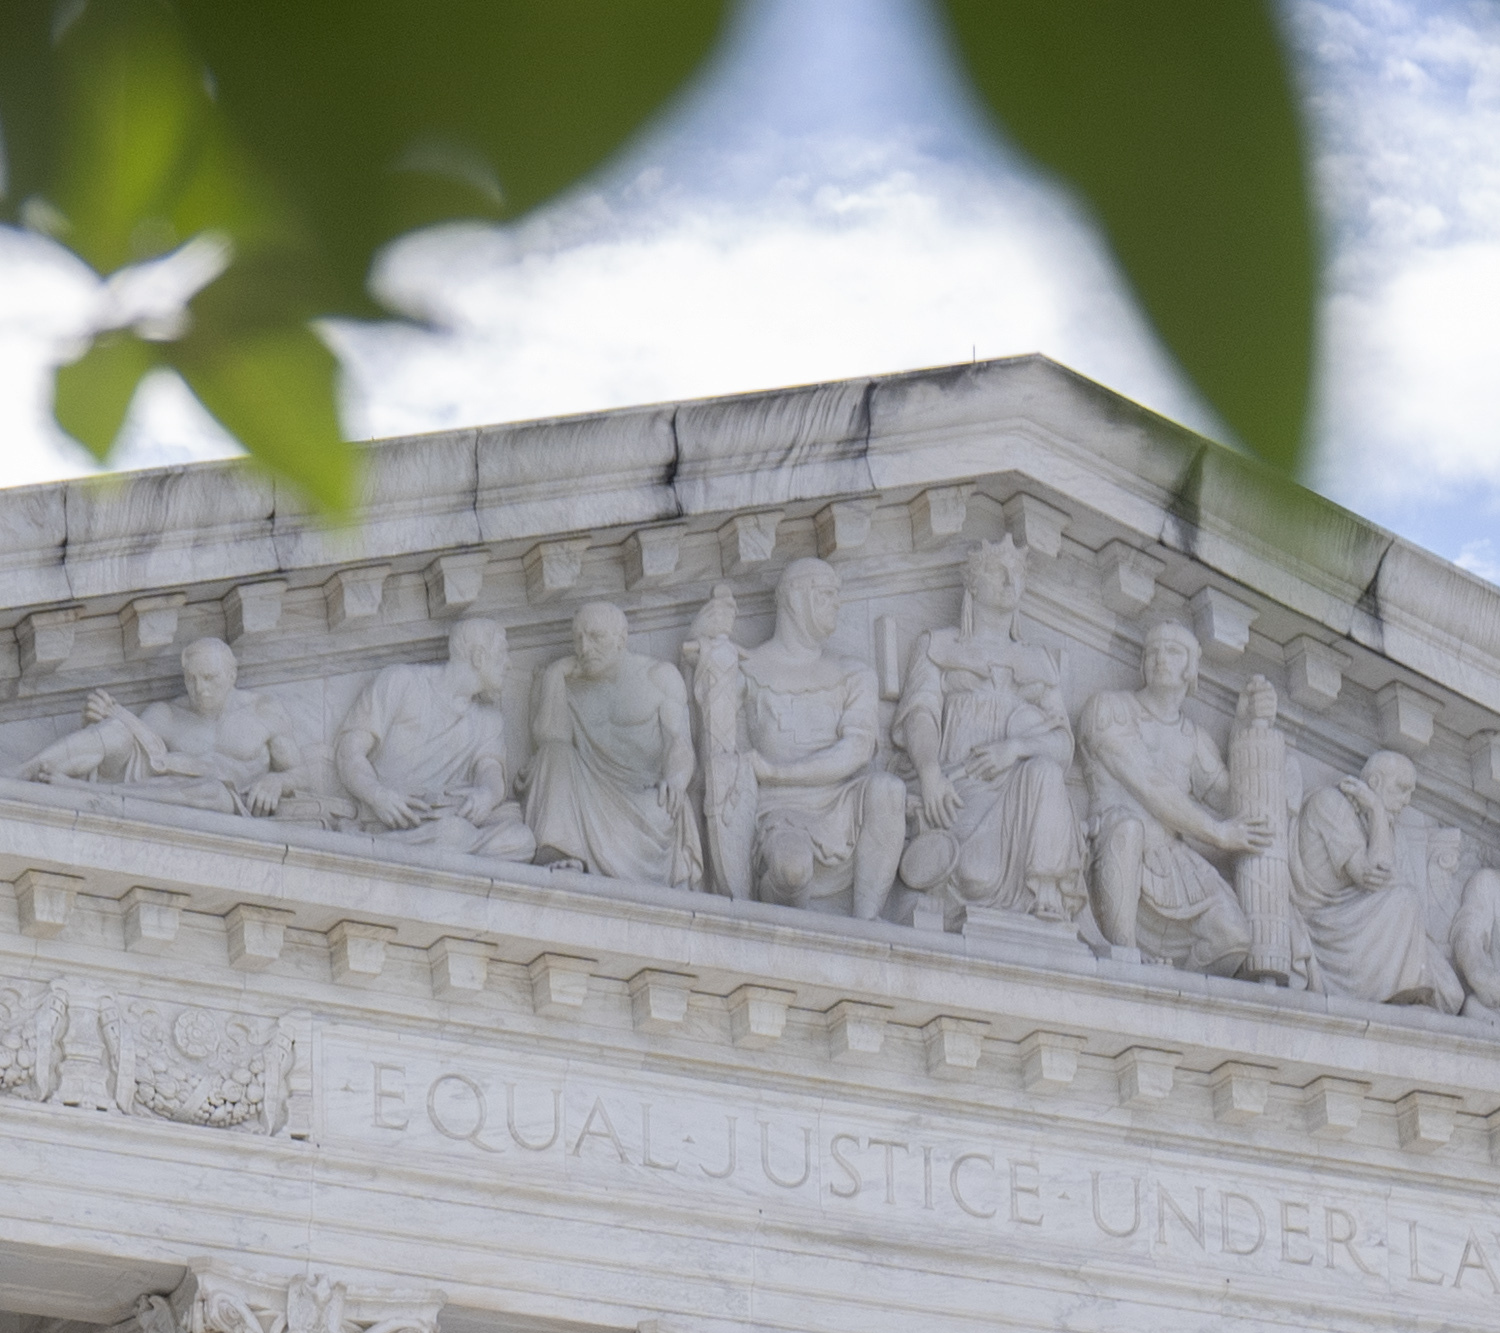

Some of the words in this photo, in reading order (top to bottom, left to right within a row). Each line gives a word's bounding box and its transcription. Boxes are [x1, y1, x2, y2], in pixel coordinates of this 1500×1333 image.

[370, 1060, 680, 1172] EQUAL
[698, 1114, 1044, 1227] JUSTICE
[1090, 1169, 1382, 1279] UNDER
